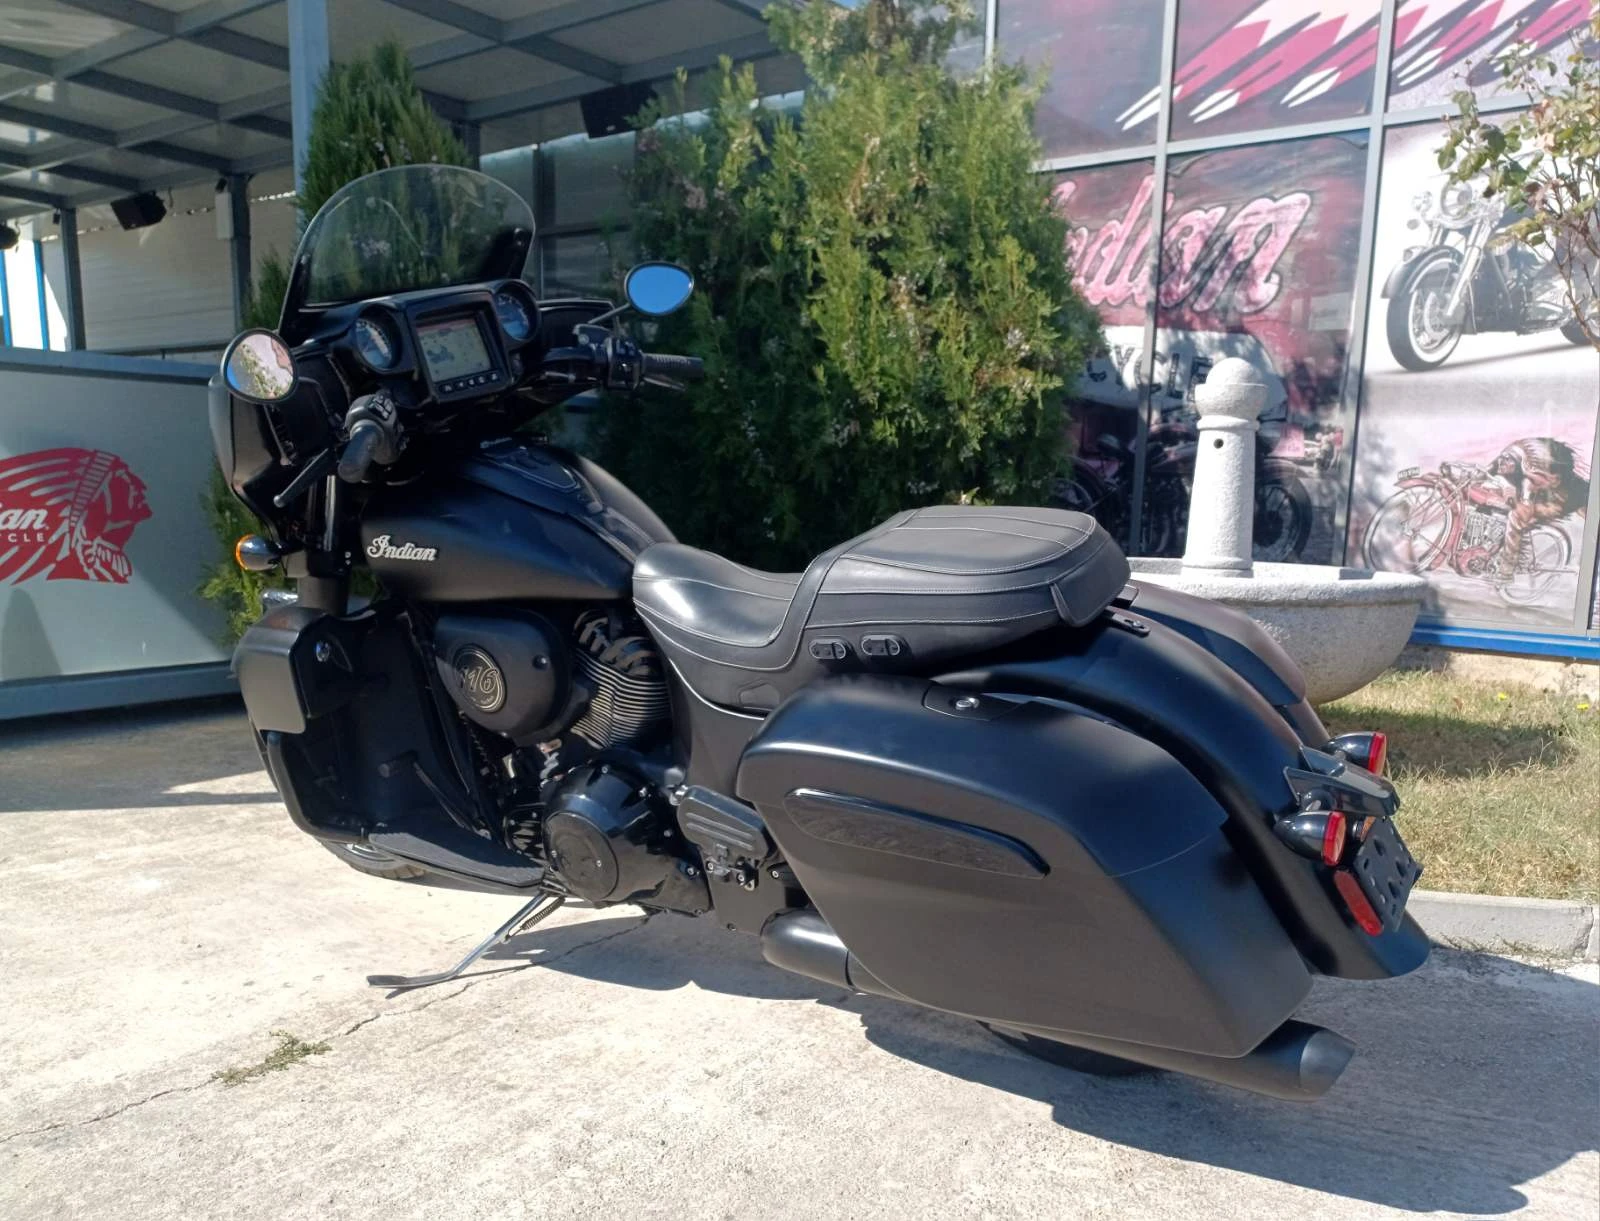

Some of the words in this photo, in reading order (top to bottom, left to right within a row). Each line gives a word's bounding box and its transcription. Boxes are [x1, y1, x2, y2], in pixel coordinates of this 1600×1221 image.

[1052, 175, 1312, 313] ndian
[4, 533, 45, 543] CLE
[366, 534, 438, 561] Indian
